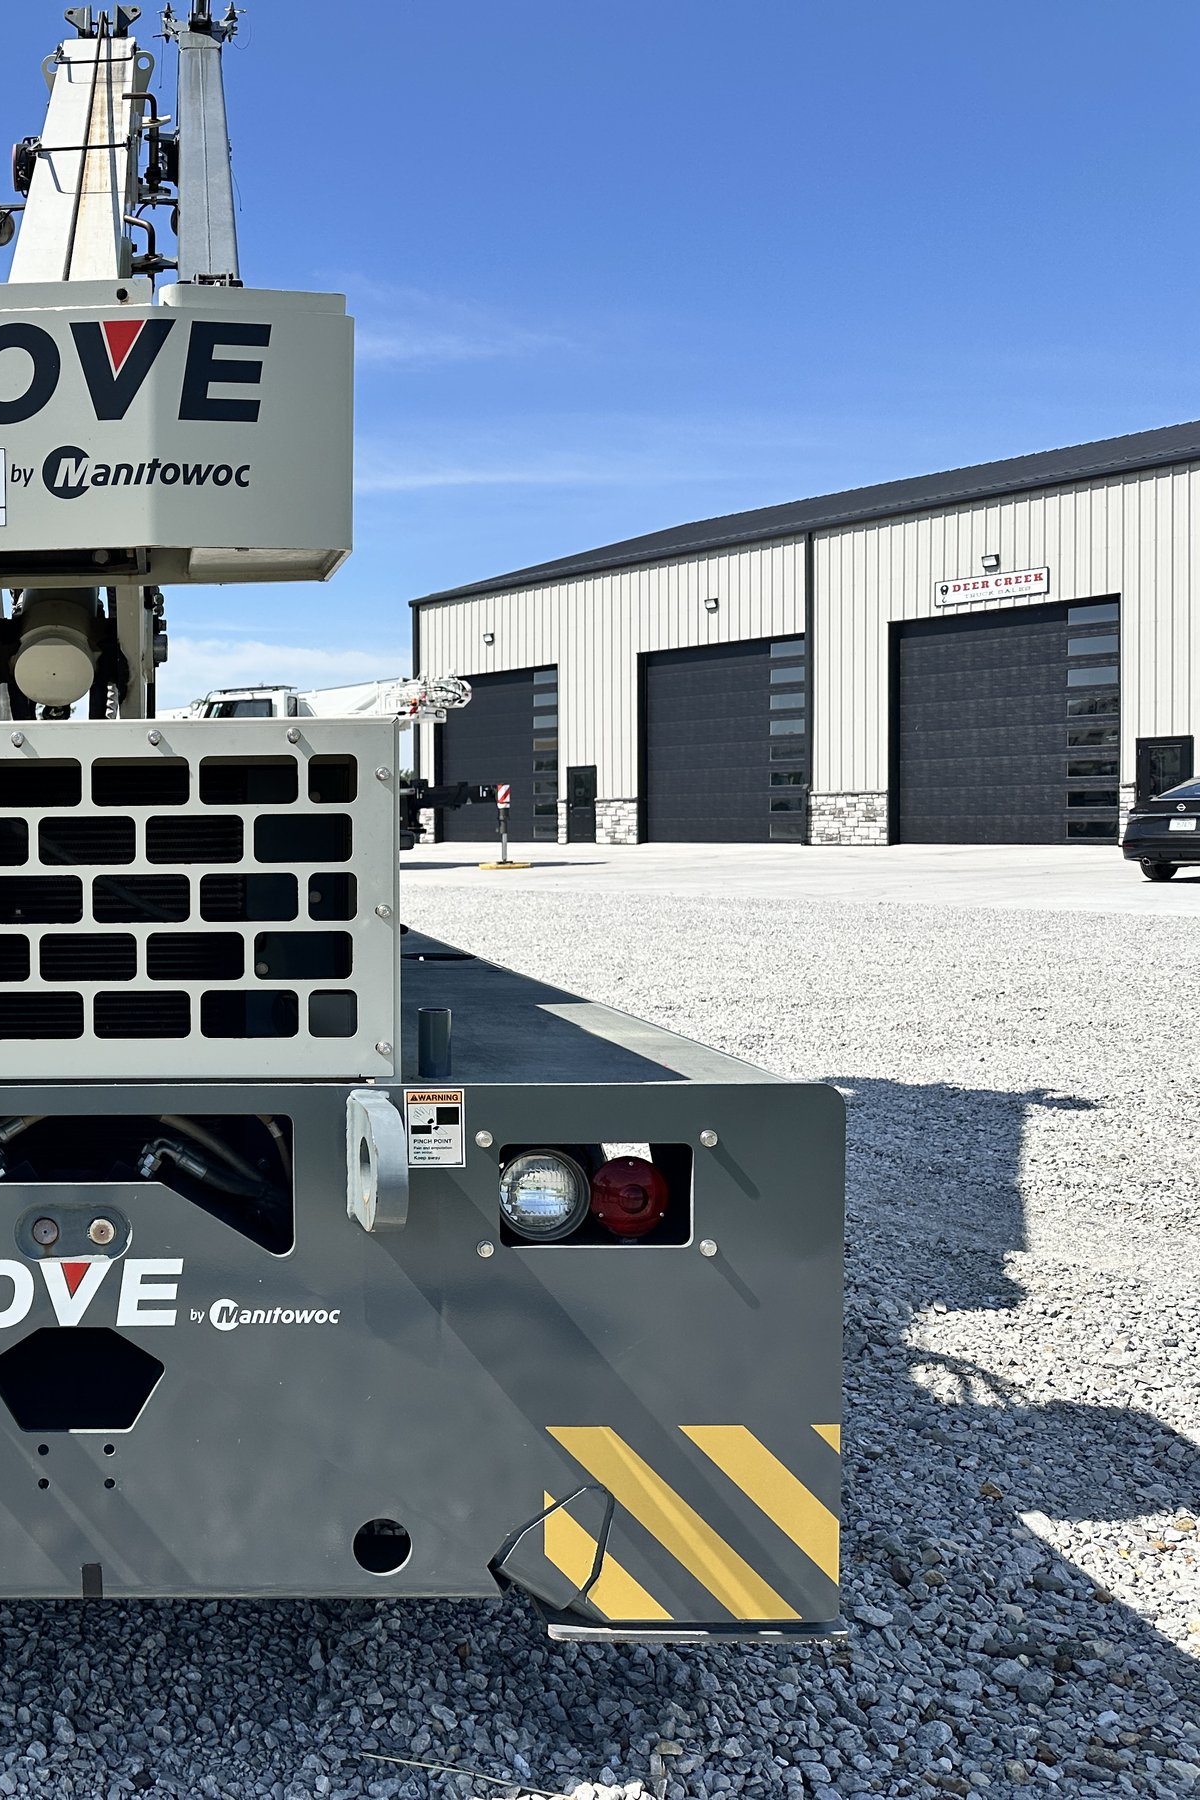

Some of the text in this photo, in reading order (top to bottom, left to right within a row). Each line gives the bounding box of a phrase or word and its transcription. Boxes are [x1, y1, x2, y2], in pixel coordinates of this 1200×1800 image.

[11, 446, 250, 499] by Manitowoc
[952, 573, 1043, 592] DEER CREEK
[189, 1308, 205, 1324] by
[209, 1298, 341, 1331] Manitowoc
